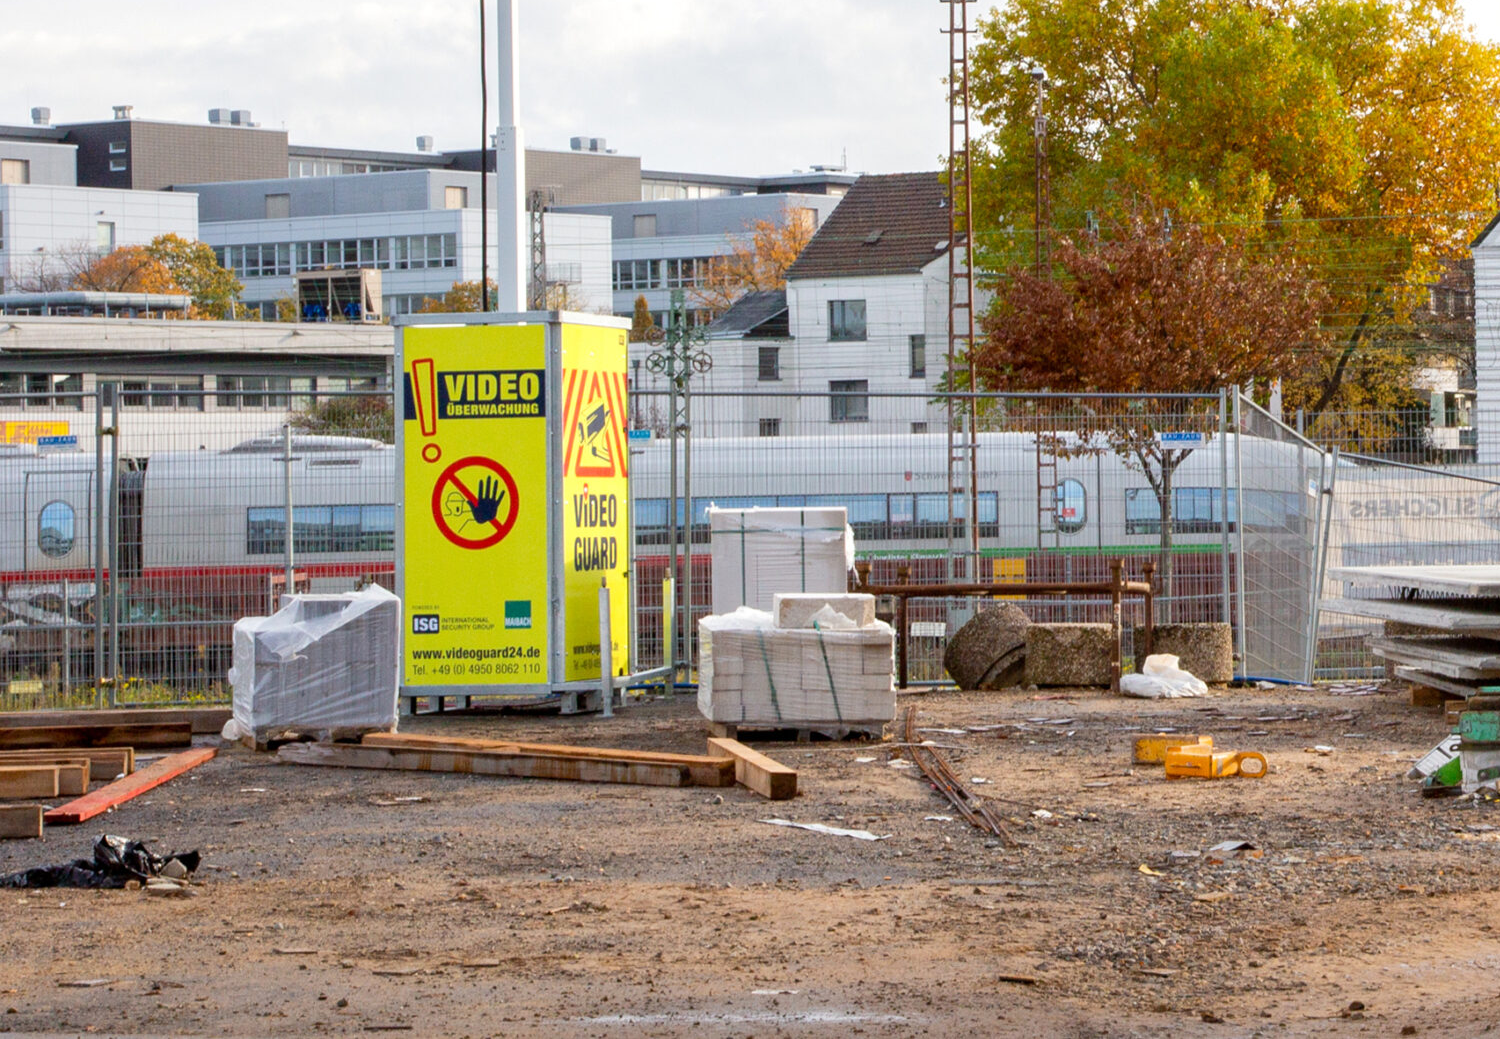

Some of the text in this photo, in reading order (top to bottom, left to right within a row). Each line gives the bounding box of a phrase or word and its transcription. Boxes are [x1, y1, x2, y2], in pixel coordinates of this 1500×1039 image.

[444, 372, 540, 401] VIDEO
[446, 402, 539, 416] ÜBERWACHUNG
[573, 537, 617, 571] GUARD
[413, 617, 438, 632] ISG
[505, 617, 532, 627] MAIBACH
[412, 646, 541, 661] www.videoguard24.de
[413, 662, 540, 676] Tel. +49 (0) 4950 8062 110
